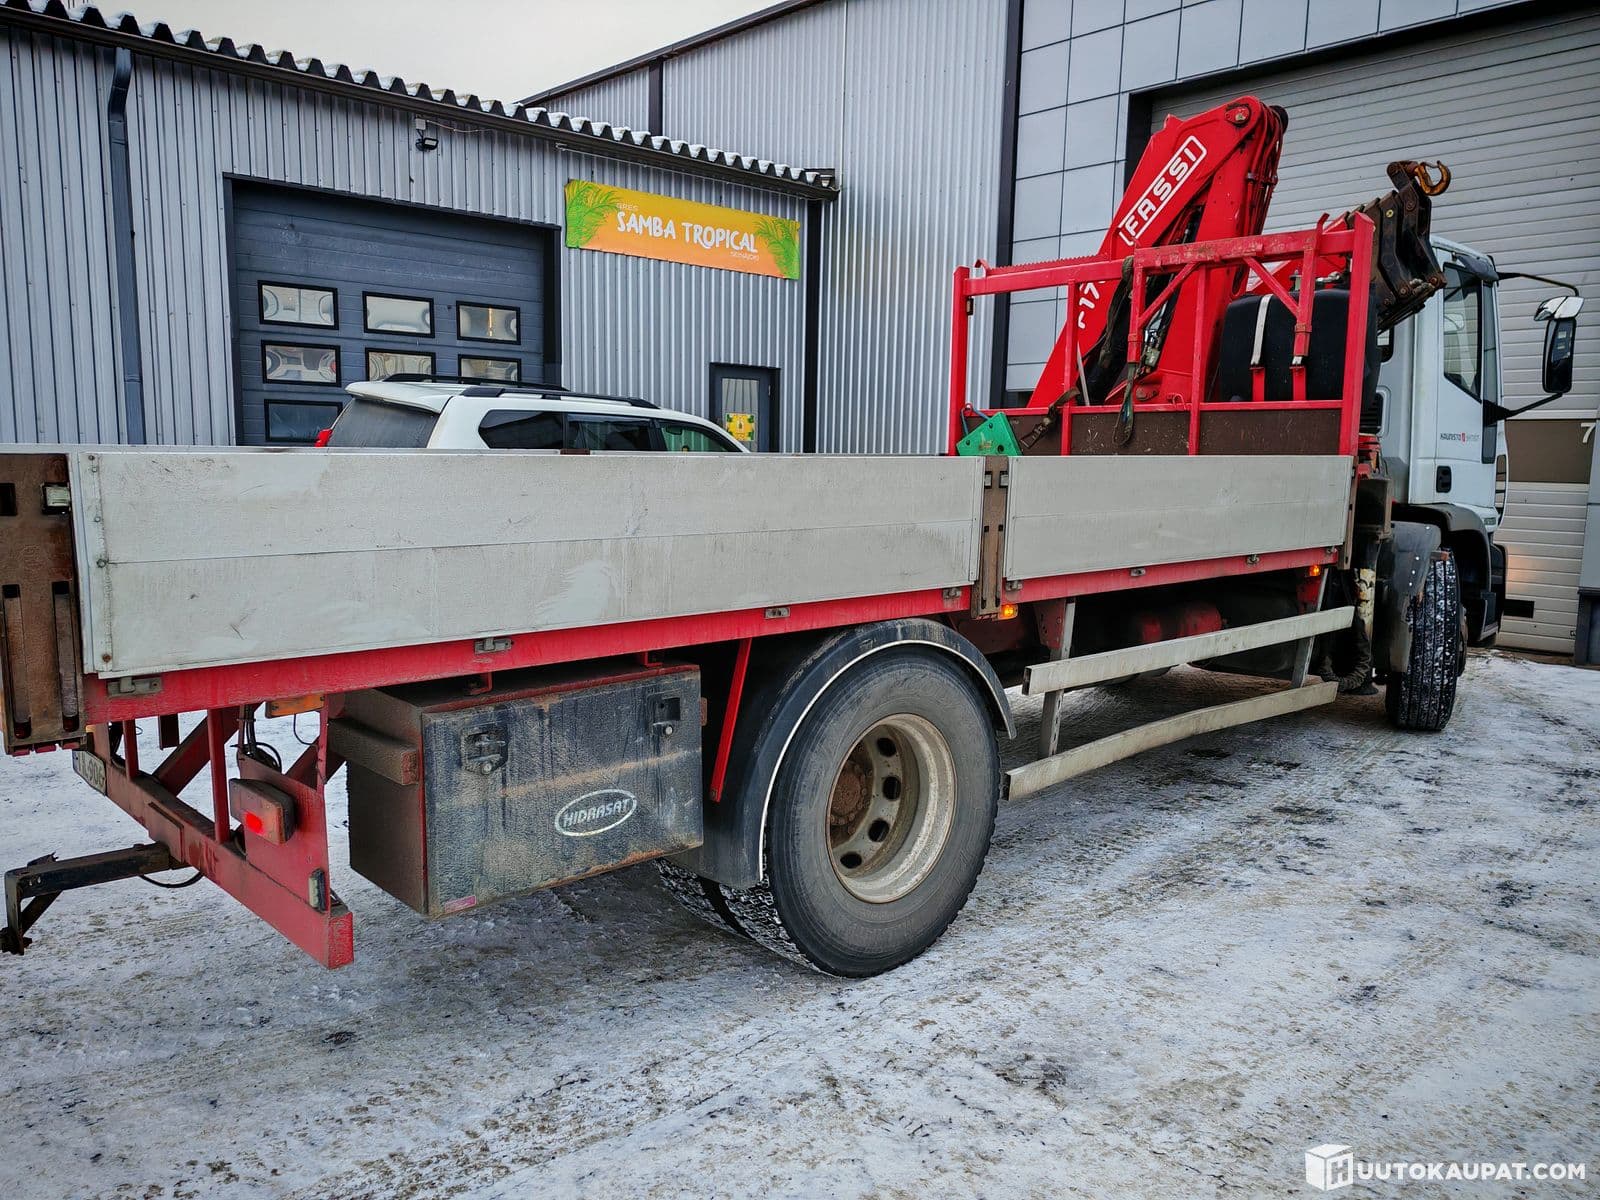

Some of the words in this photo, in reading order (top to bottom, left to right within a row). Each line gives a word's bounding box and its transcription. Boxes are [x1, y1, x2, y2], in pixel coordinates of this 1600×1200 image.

[1126, 147, 1197, 237] FASSI
[617, 211, 676, 240] SAMBA
[681, 222, 758, 254] TROPICAL
[1580, 422, 1597, 444] 7
[562, 798, 631, 828] HIDRASAT
